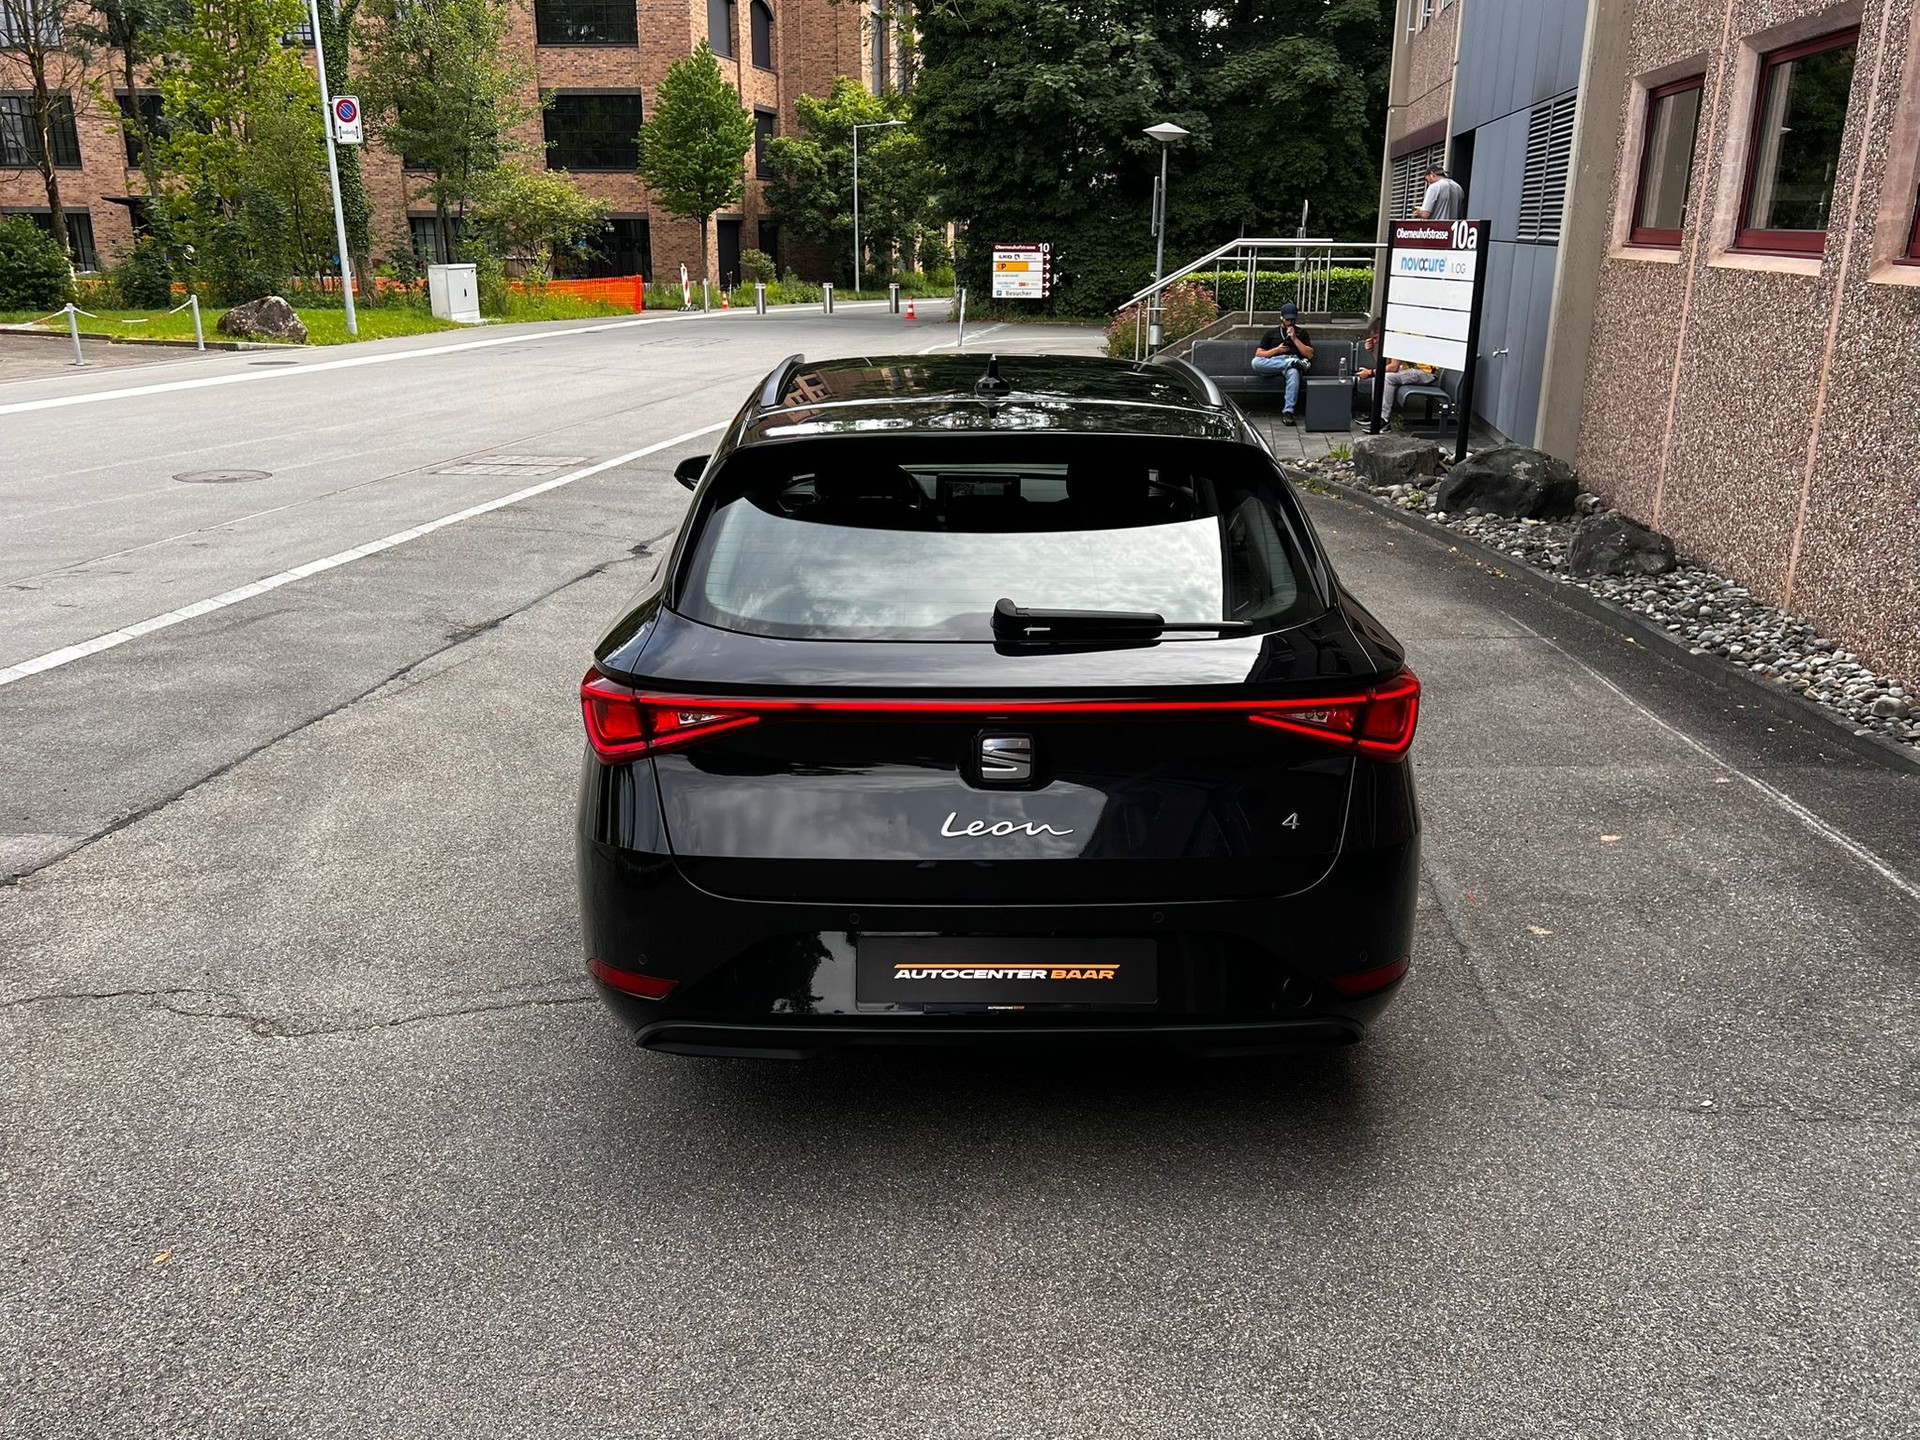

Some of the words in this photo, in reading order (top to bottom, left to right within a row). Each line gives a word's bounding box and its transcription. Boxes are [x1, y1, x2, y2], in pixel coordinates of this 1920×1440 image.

[1396, 227, 1449, 239] Oberneuhofstrasse
[1451, 220, 1478, 249] 10a
[1038, 243, 1050, 252] 10
[1401, 256, 1446, 272] novocure
[941, 811, 1074, 837] Leon
[1282, 812, 1300, 830] 4
[893, 969, 1047, 980] AUTOCENTER
[1050, 969, 1115, 980] BAAR
